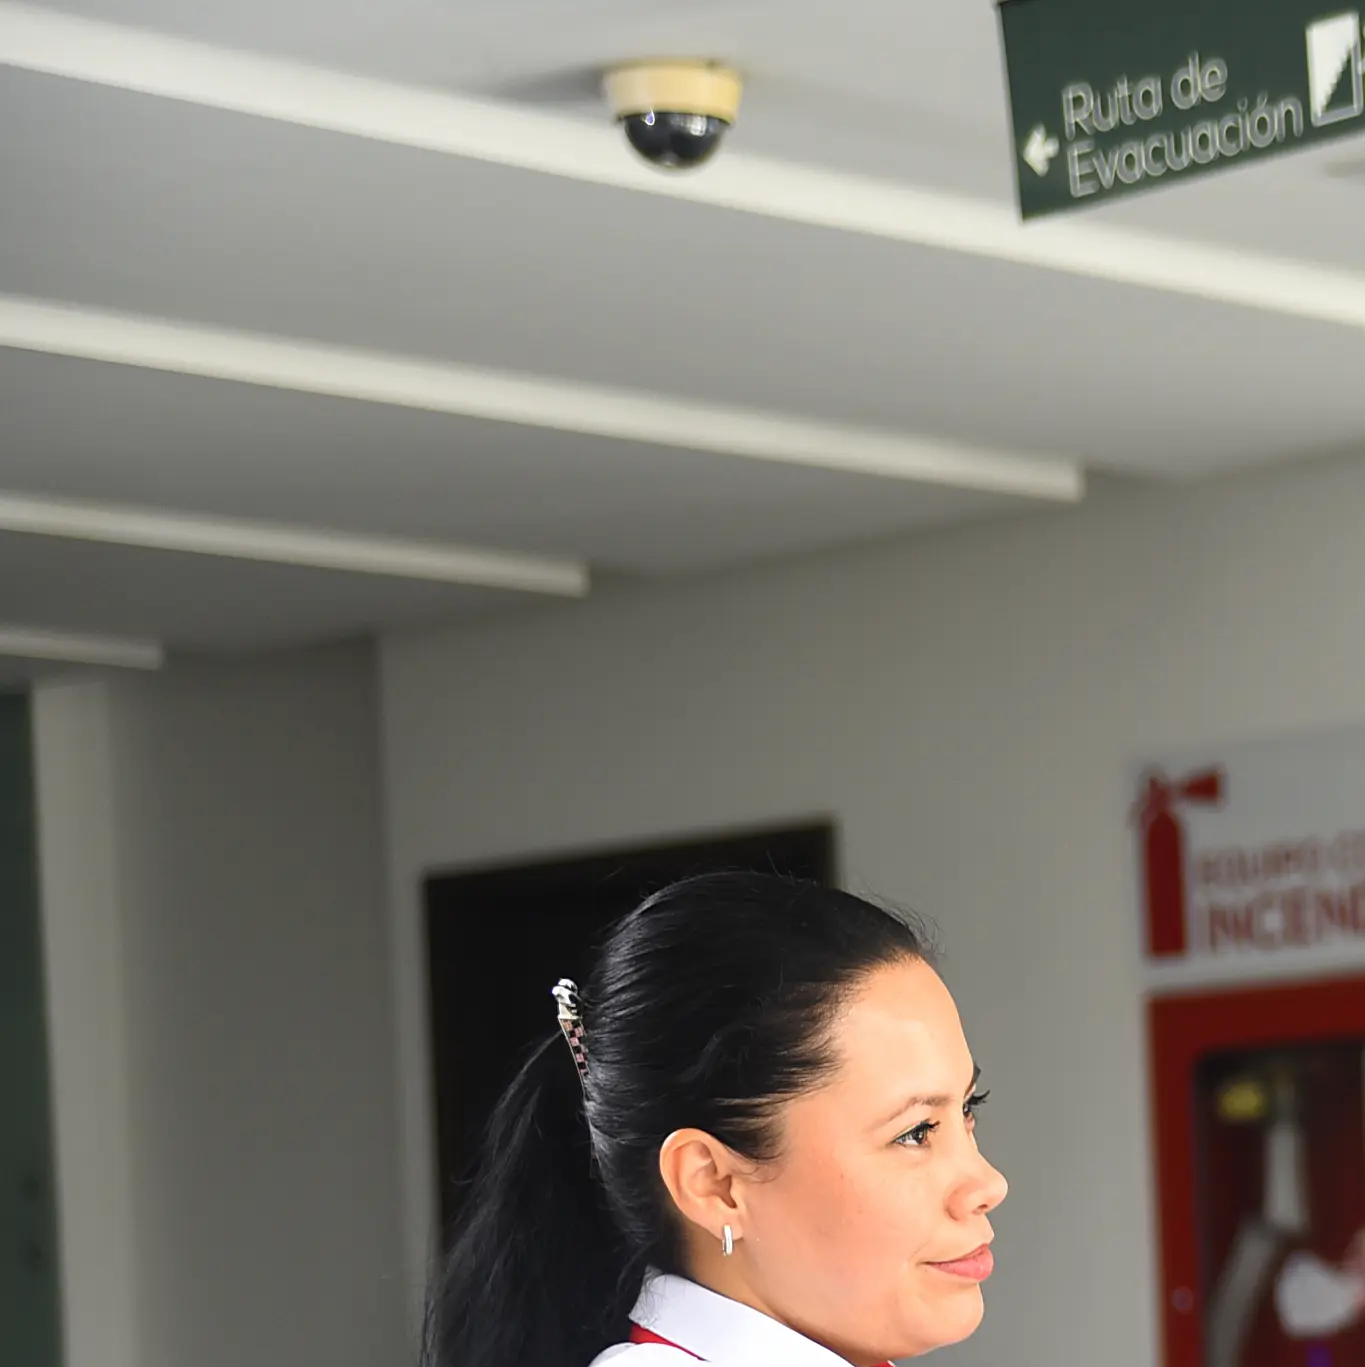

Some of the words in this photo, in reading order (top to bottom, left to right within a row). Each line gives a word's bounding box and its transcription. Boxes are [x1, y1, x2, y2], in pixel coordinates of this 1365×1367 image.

[1062, 74, 1163, 140] Ruta
[1171, 51, 1228, 110] de
[1066, 92, 1304, 197] Evacuación
